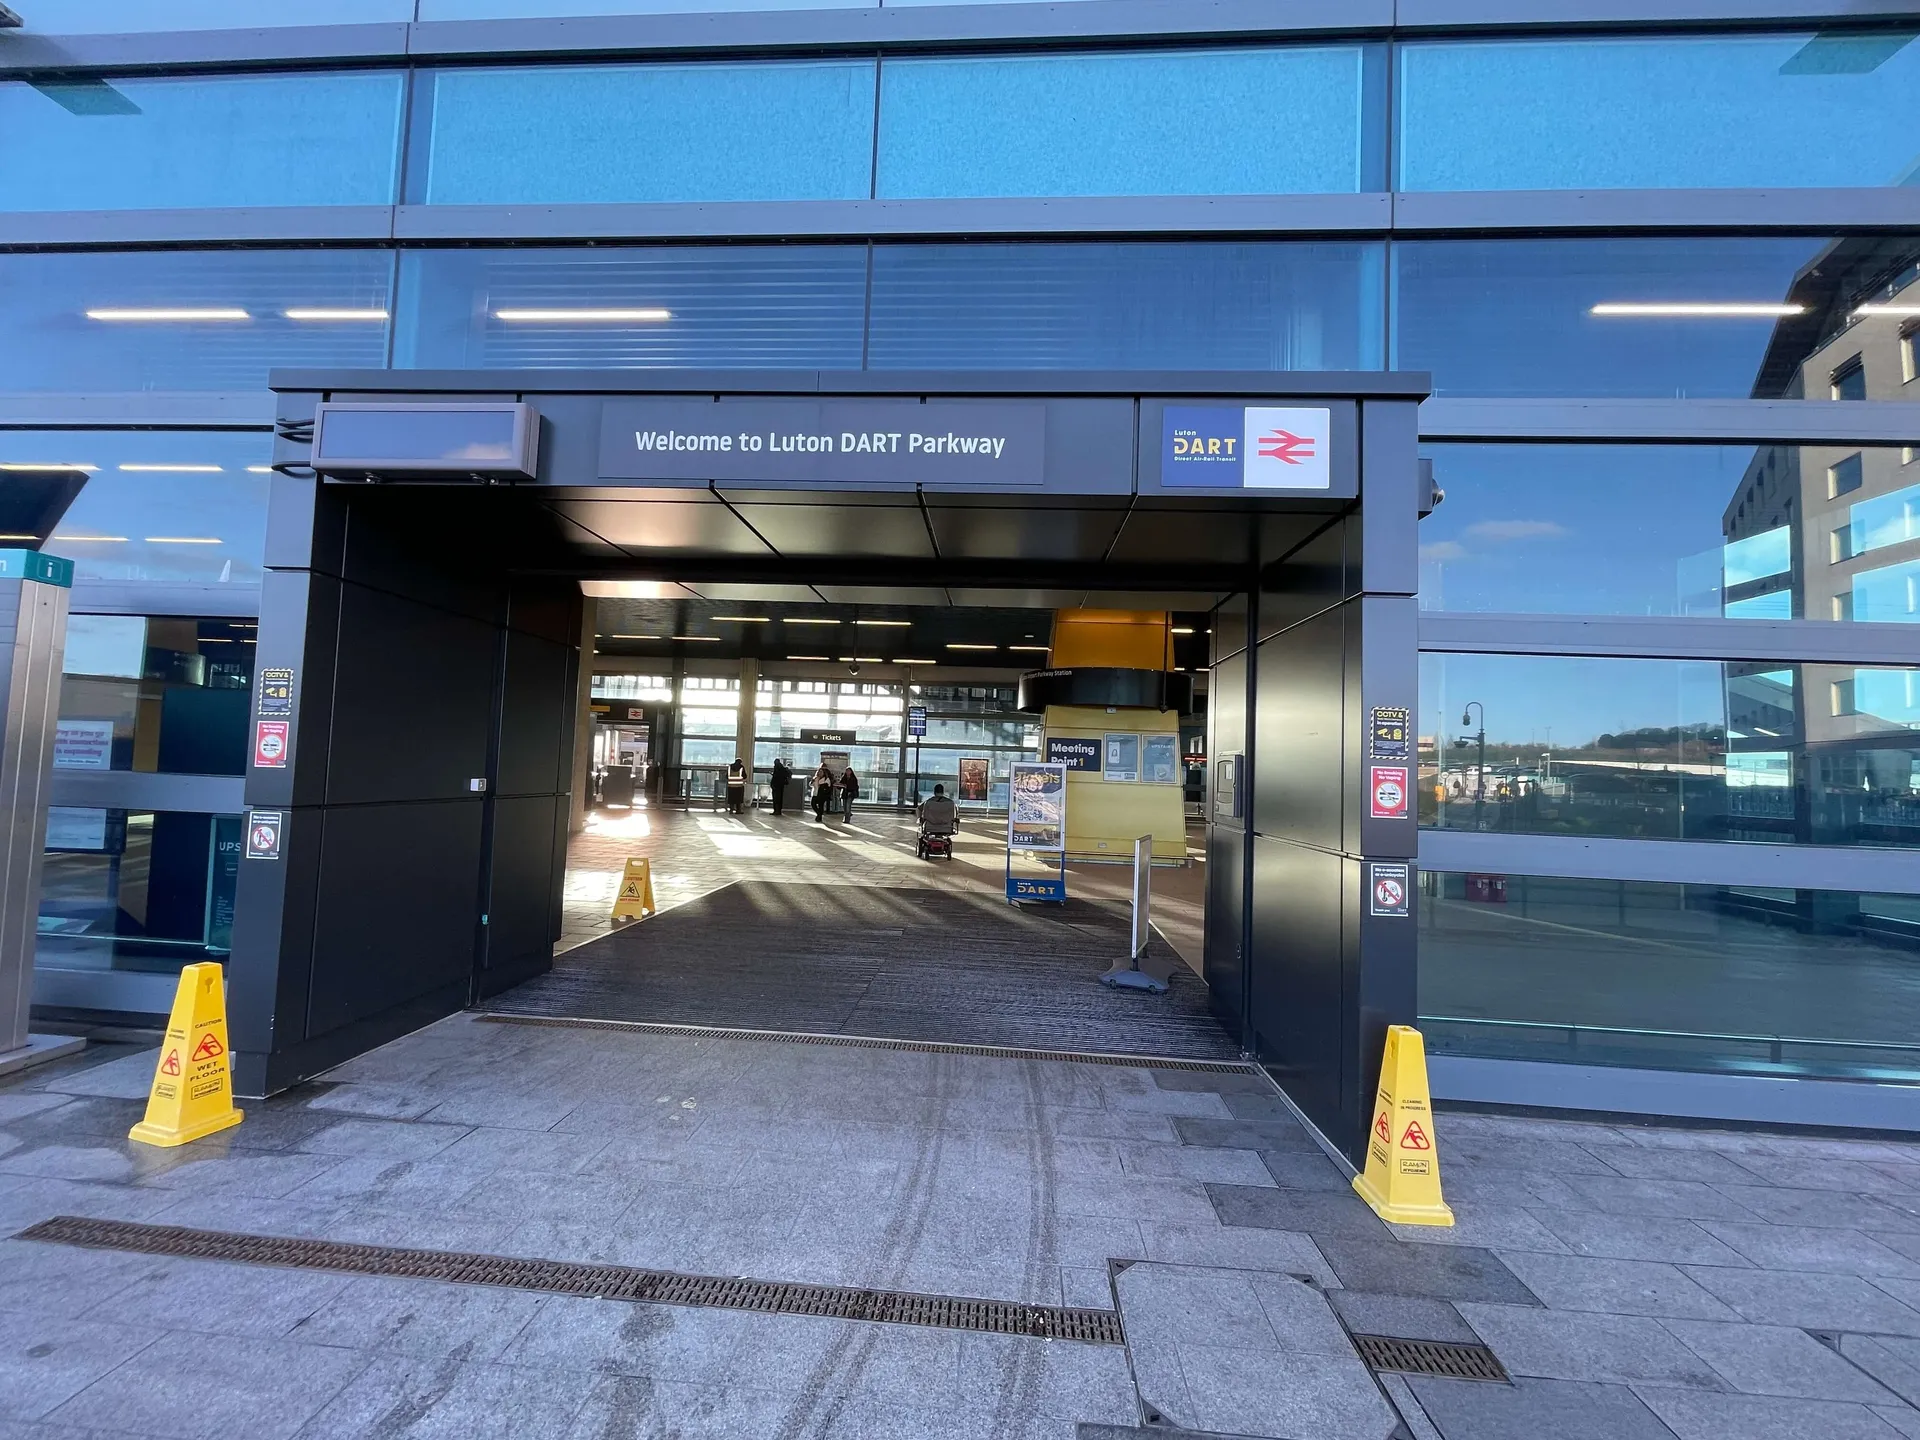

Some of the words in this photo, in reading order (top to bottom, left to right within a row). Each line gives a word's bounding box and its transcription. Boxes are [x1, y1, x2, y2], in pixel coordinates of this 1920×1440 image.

[635, 430, 732, 452] Welcome
[738, 432, 763, 452] to
[769, 432, 833, 453] Luton
[840, 432, 902, 453] DART
[908, 432, 1006, 459] Parkway
[1173, 437, 1236, 455] DART
[1051, 743, 1095, 756] Meeting
[1051, 756, 1078, 766] Point
[1080, 758, 1084, 766] 1
[1017, 885, 1055, 895] DART
[194, 1018, 222, 1029] CAUTION
[196, 1060, 218, 1072] WET
[190, 1066, 225, 1082] FLOOR
